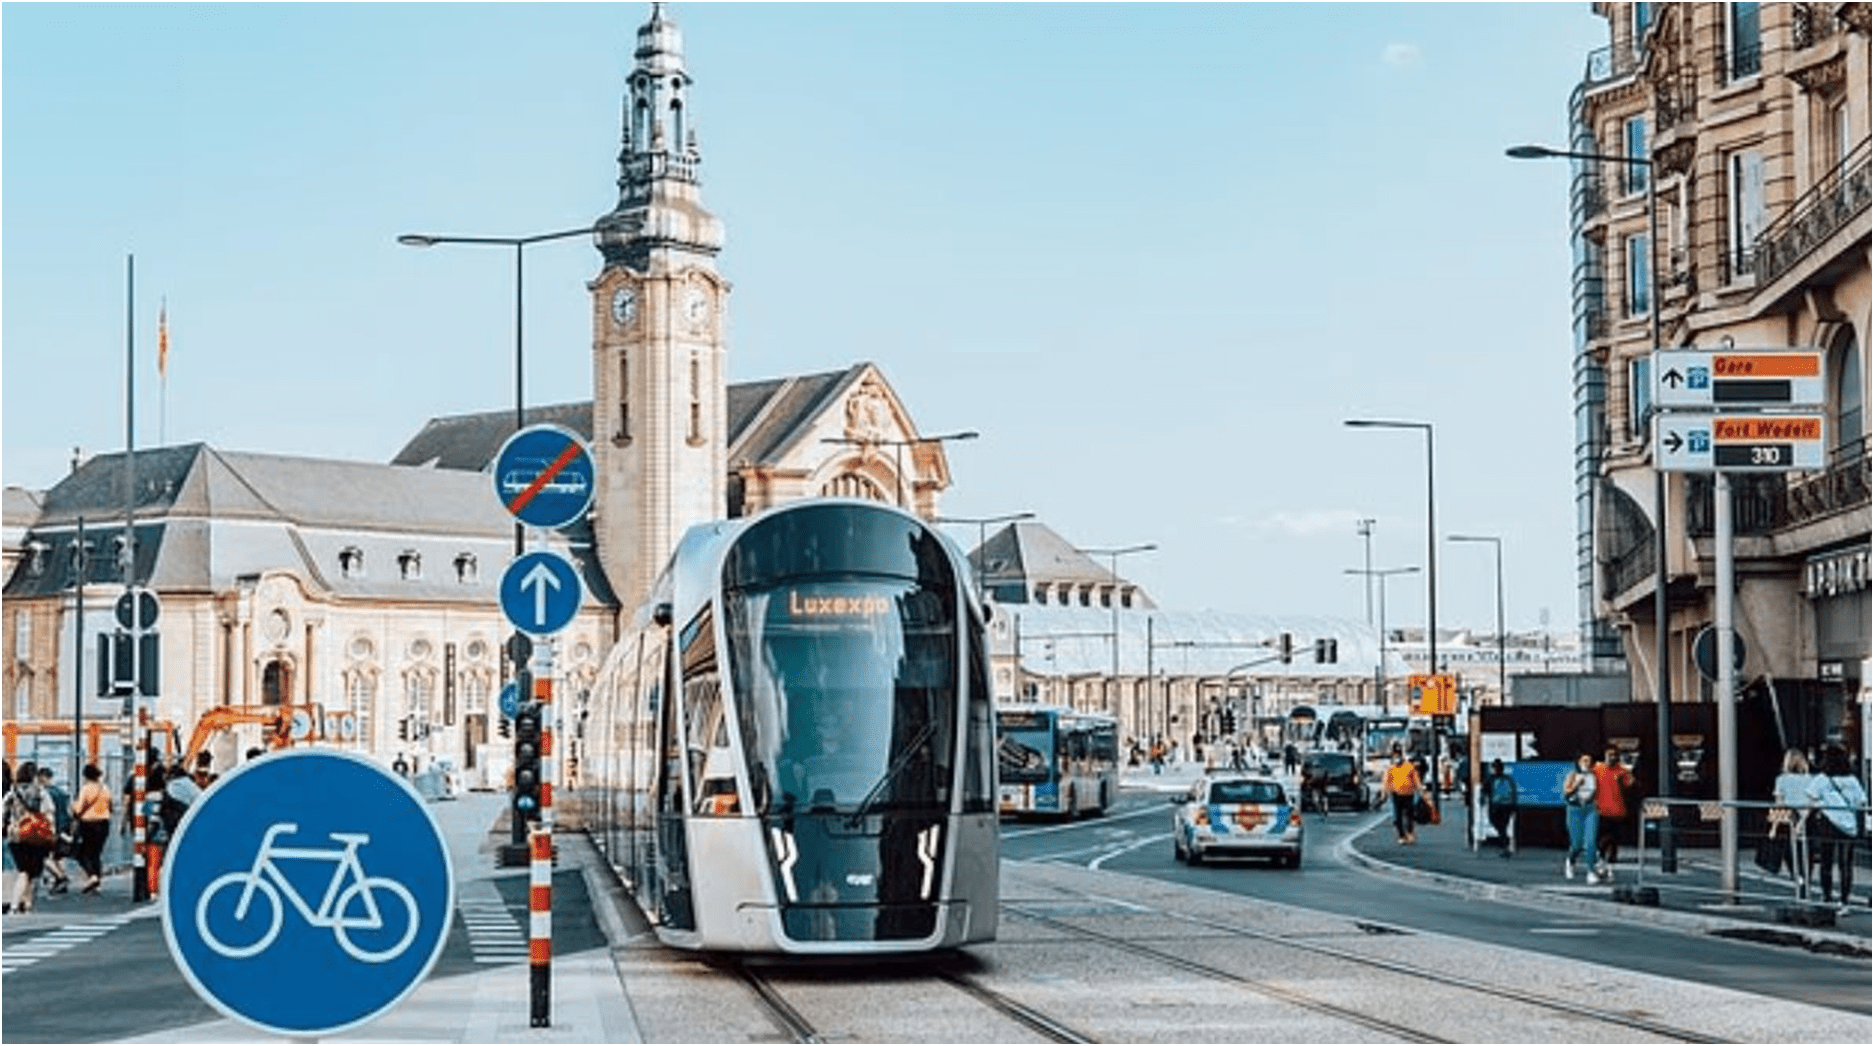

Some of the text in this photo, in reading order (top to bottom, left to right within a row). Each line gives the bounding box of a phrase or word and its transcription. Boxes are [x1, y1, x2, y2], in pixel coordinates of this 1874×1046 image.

[1715, 358, 1753, 374] Gare
[1715, 421, 1749, 437] Fort
[1751, 446, 1780, 464] 310
[790, 590, 889, 619] Luxexpo
